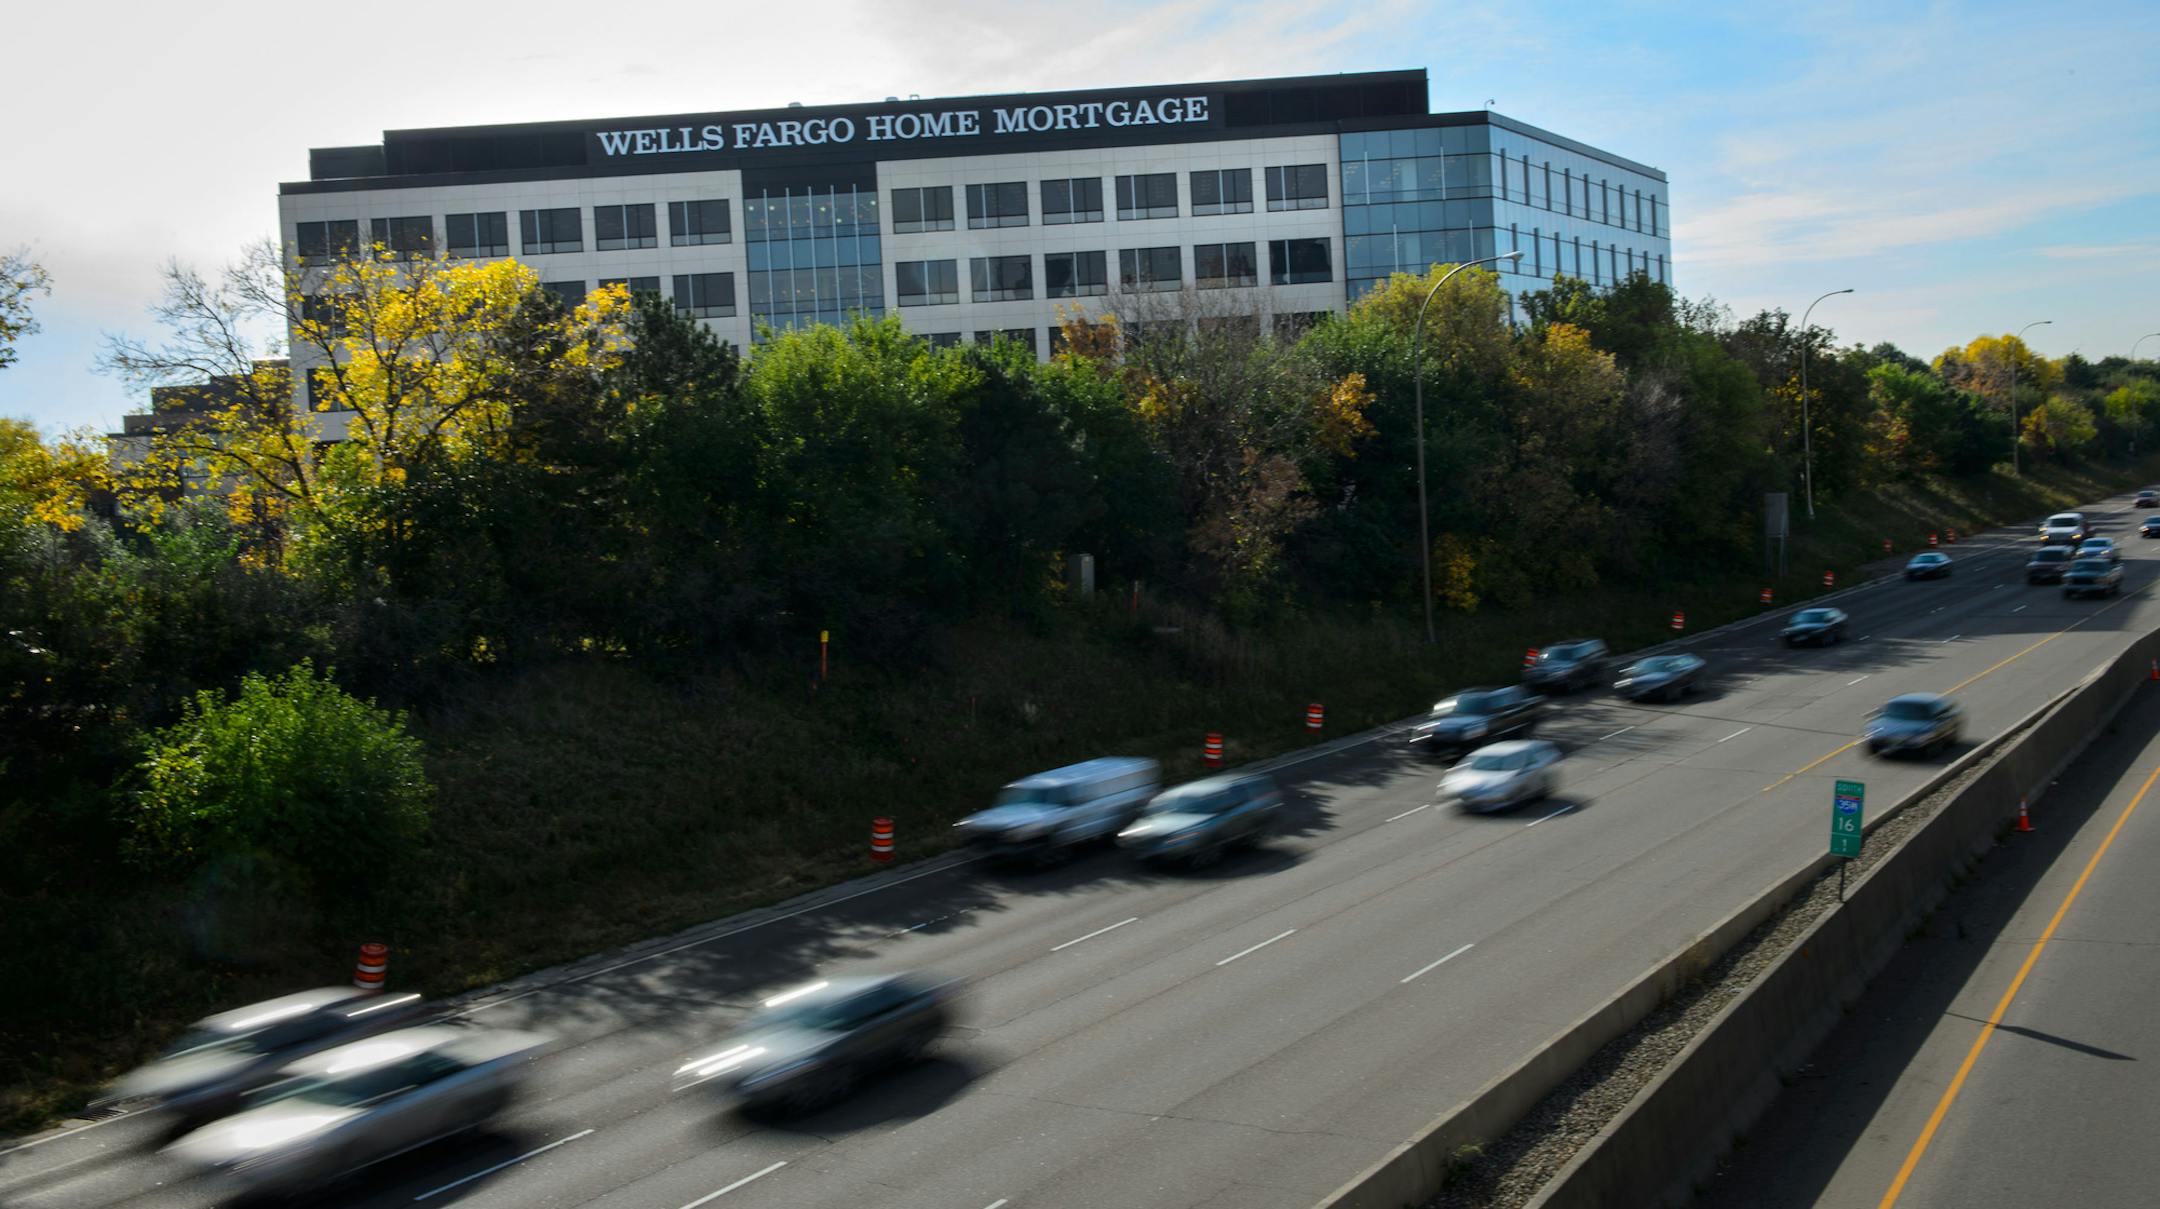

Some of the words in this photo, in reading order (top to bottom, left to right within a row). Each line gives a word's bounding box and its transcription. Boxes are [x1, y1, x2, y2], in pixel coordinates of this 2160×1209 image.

[597, 126, 724, 156] WELLS
[732, 117, 855, 149] FARGO
[866, 111, 980, 141] HOME
[993, 96, 1209, 134] MORTGAGE
[1839, 816, 1855, 832] 16
